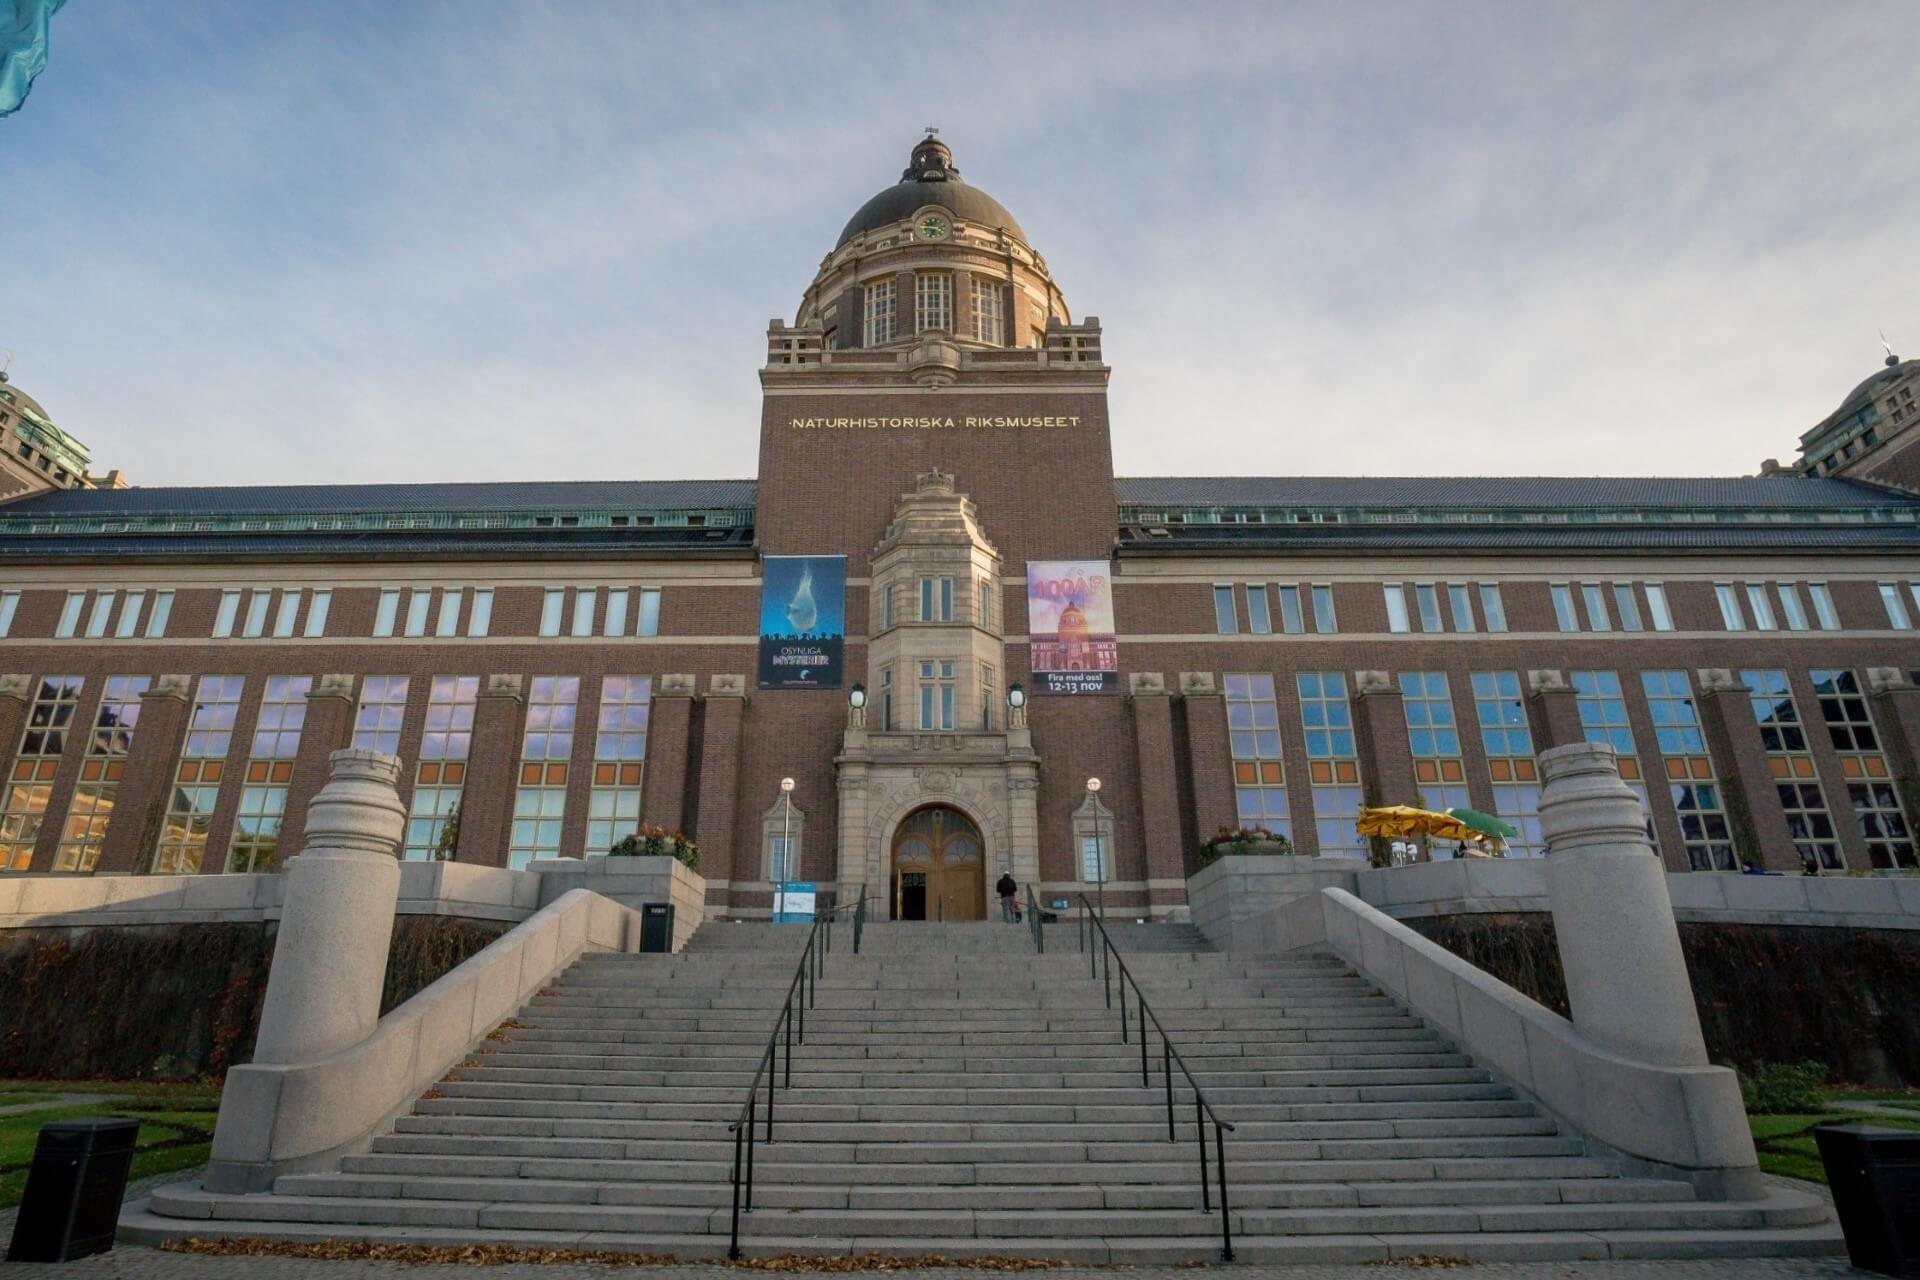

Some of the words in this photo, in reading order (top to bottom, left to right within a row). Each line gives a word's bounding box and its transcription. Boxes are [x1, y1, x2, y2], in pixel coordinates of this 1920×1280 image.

[792, 416, 956, 429] NATURHISTORISKA
[965, 416, 1080, 428] RIKSMUSEET
[780, 646, 822, 655] OSYNLIGA
[1065, 672, 1084, 681] med
[1048, 682, 1078, 694] 12-13
[1080, 682, 1104, 691] nov
